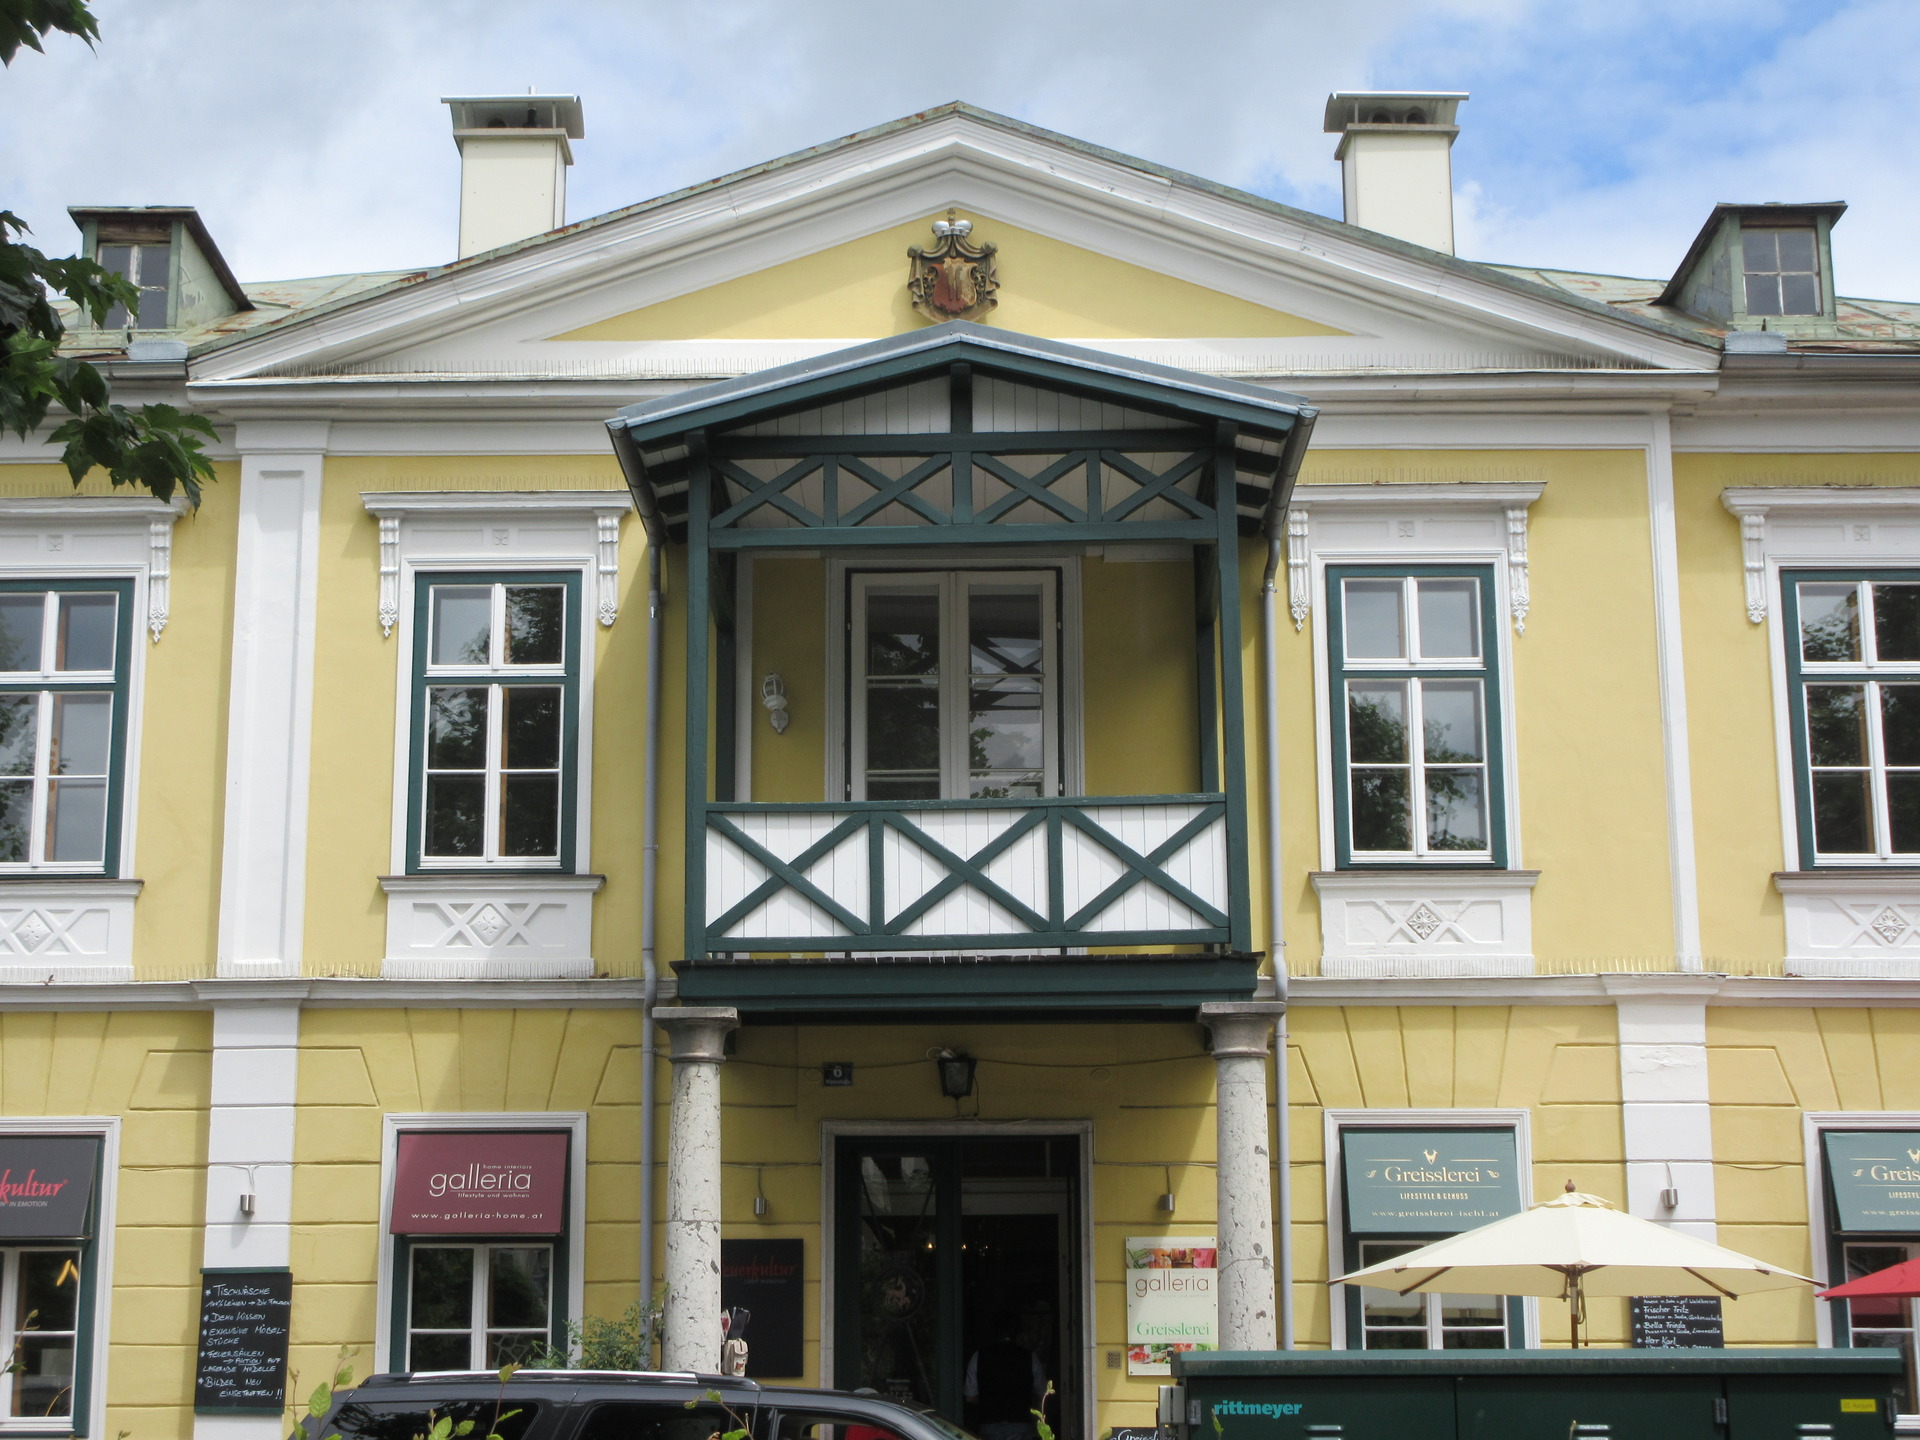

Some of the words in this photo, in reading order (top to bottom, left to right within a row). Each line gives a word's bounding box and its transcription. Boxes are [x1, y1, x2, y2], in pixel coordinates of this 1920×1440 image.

[429, 1163, 531, 1197] galleria
[1384, 1166, 1481, 1183] Greisslerei
[1400, 1192, 1435, 1200] LIFESTYLE
[1443, 1192, 1469, 1200] GENUSS
[411, 1211, 543, 1220] www.galleria-home.at
[1371, 1208, 1500, 1218] www.greisslerei-ischl.at
[1135, 1270, 1209, 1298] galleria
[1136, 1322, 1210, 1336] Greisslerei
[1643, 1321, 1663, 1329] Bella
[1662, 1336, 1677, 1345] Karl
[1214, 1400, 1303, 1419] rittmeyer
